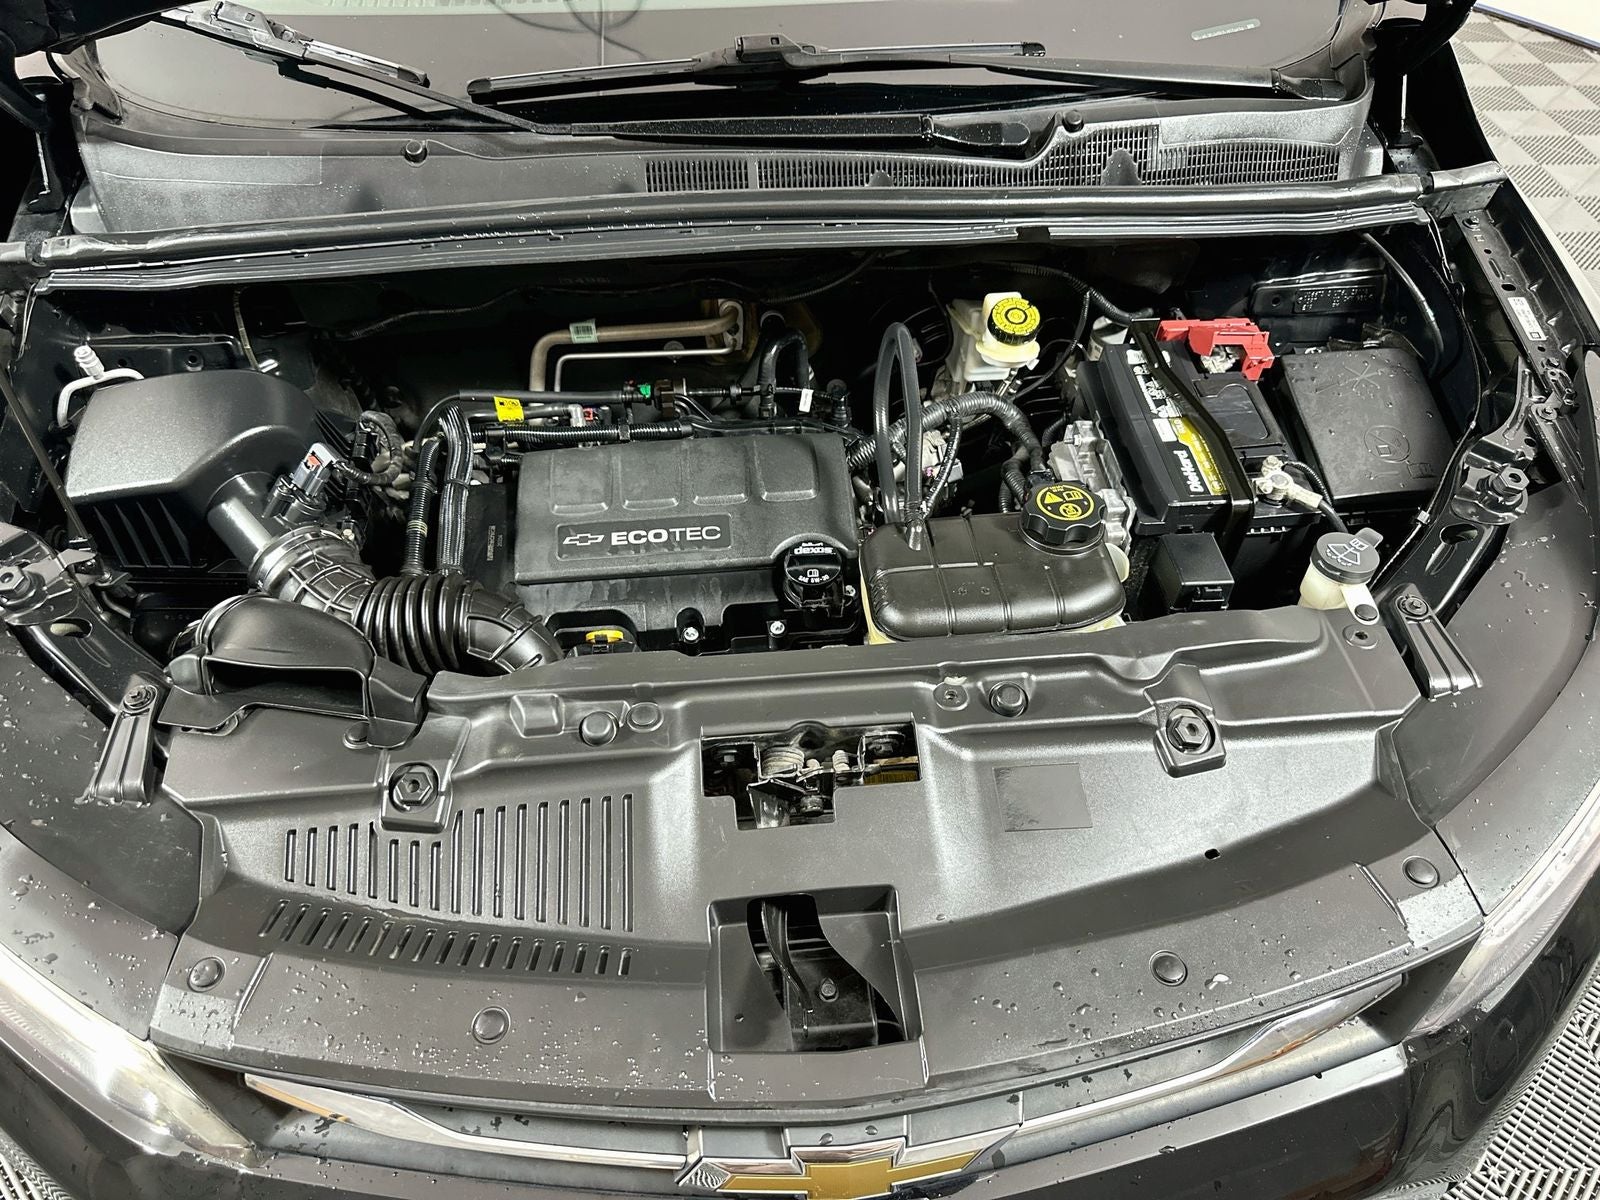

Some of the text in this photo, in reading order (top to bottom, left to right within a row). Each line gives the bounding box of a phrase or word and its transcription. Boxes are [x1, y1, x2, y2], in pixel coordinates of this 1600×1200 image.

[1173, 449, 1205, 494] DieHard
[610, 525, 722, 547] ECOTEC
[793, 546, 834, 555] dexos
